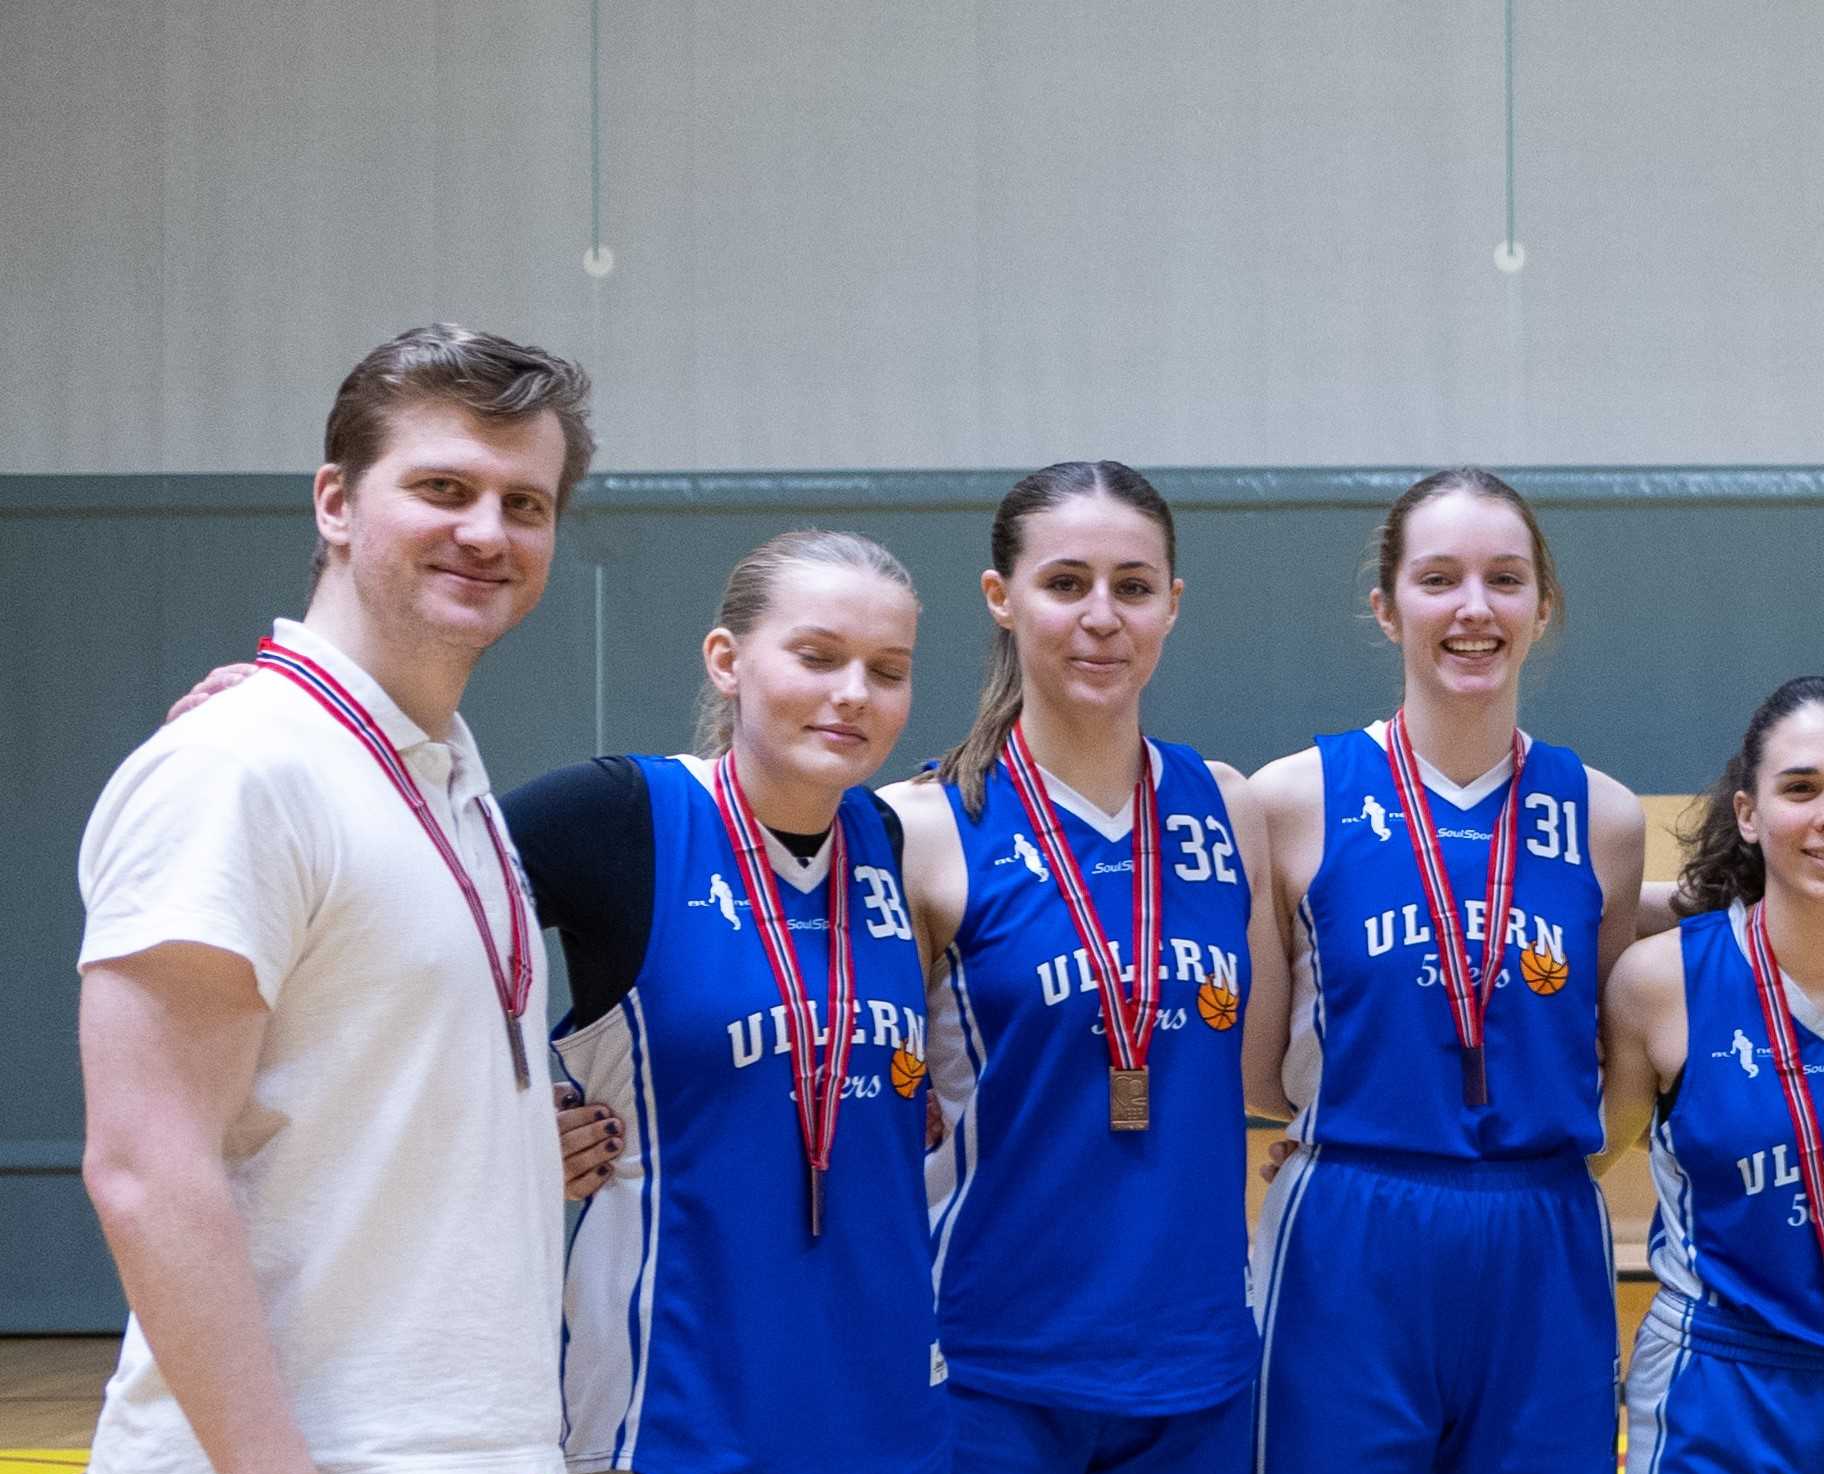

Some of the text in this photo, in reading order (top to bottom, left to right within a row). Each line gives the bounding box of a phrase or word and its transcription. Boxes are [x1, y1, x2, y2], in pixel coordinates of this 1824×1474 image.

[1166, 814, 1238, 885] 32
[1525, 793, 1582, 866] 31
[854, 865, 912, 941] 33
